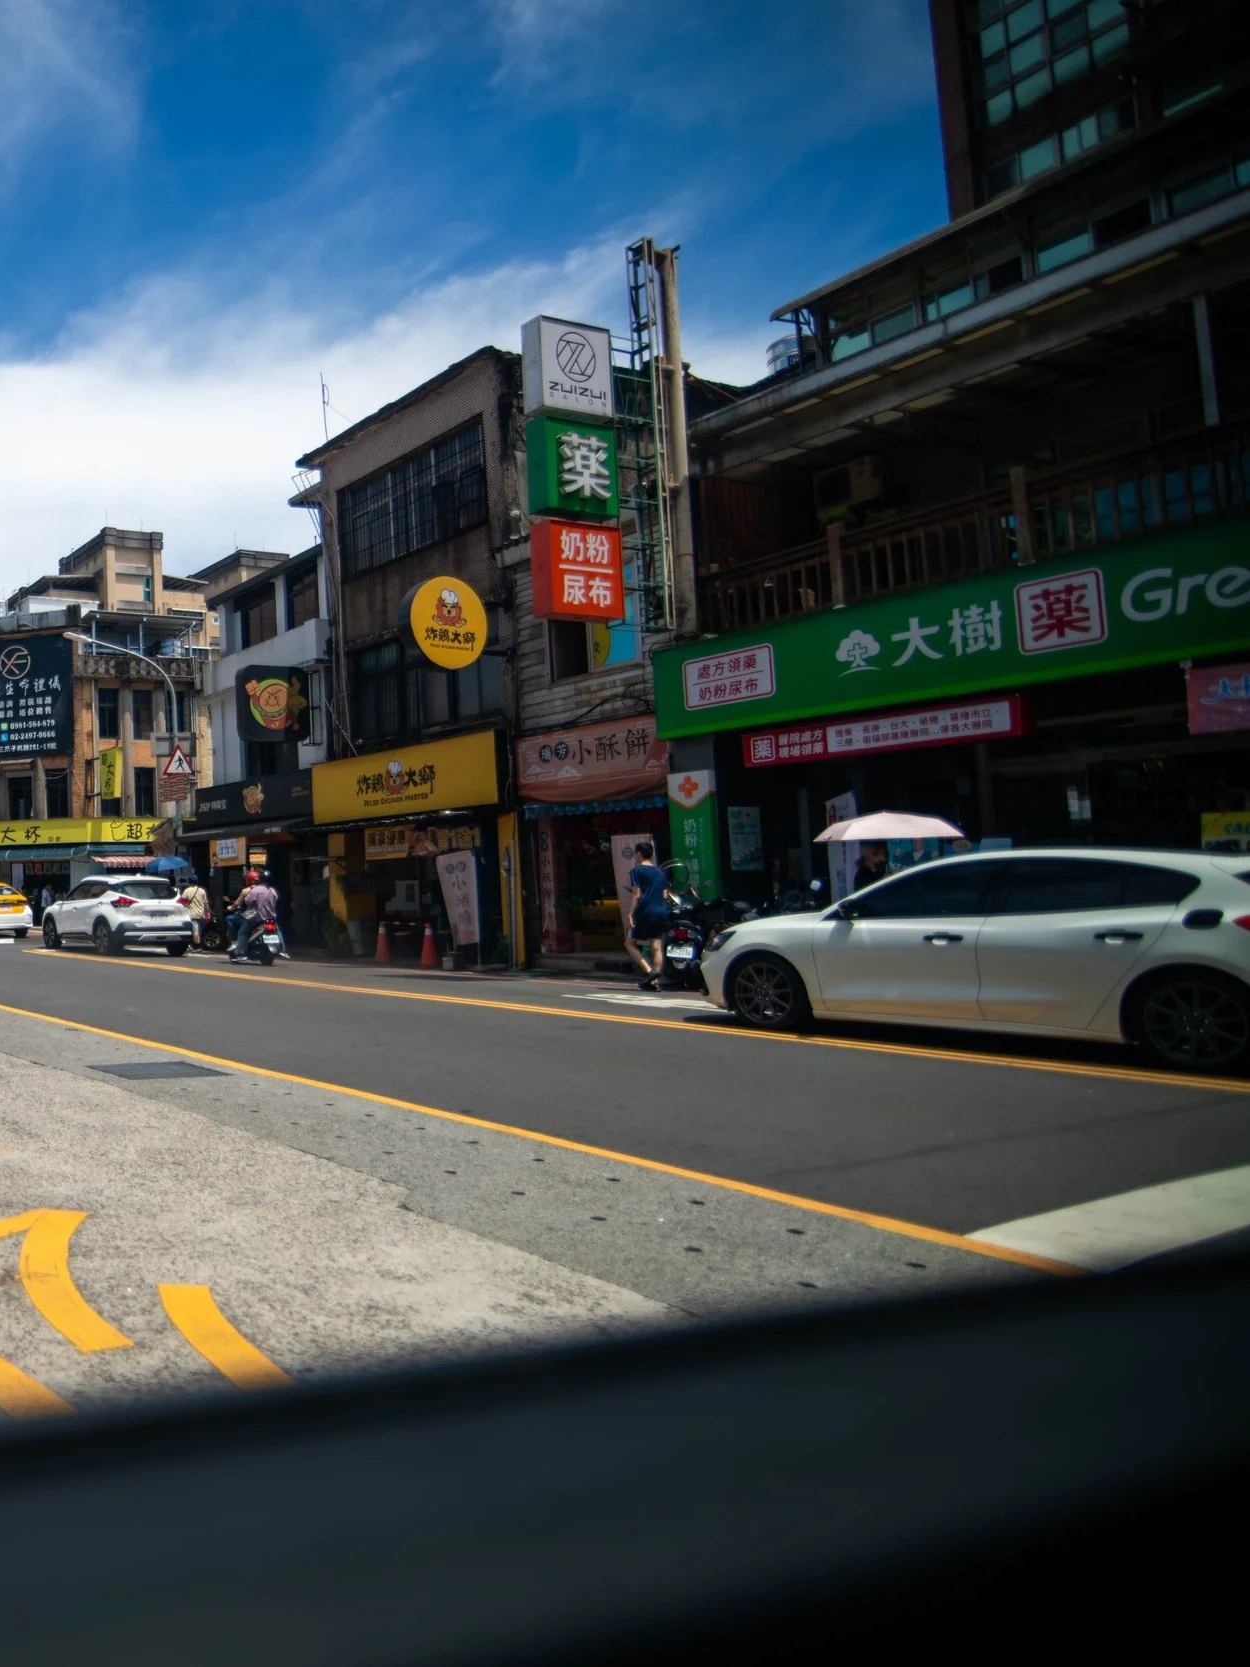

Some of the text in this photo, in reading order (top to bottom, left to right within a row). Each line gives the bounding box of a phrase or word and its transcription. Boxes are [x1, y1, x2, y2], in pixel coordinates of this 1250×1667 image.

[548, 381, 607, 401] ZUIZUI
[560, 529, 610, 564] 奶粉
[562, 574, 612, 608] 尿布
[891, 600, 1002, 667] 大樹
[698, 678, 759, 702] 奶粉尿布
